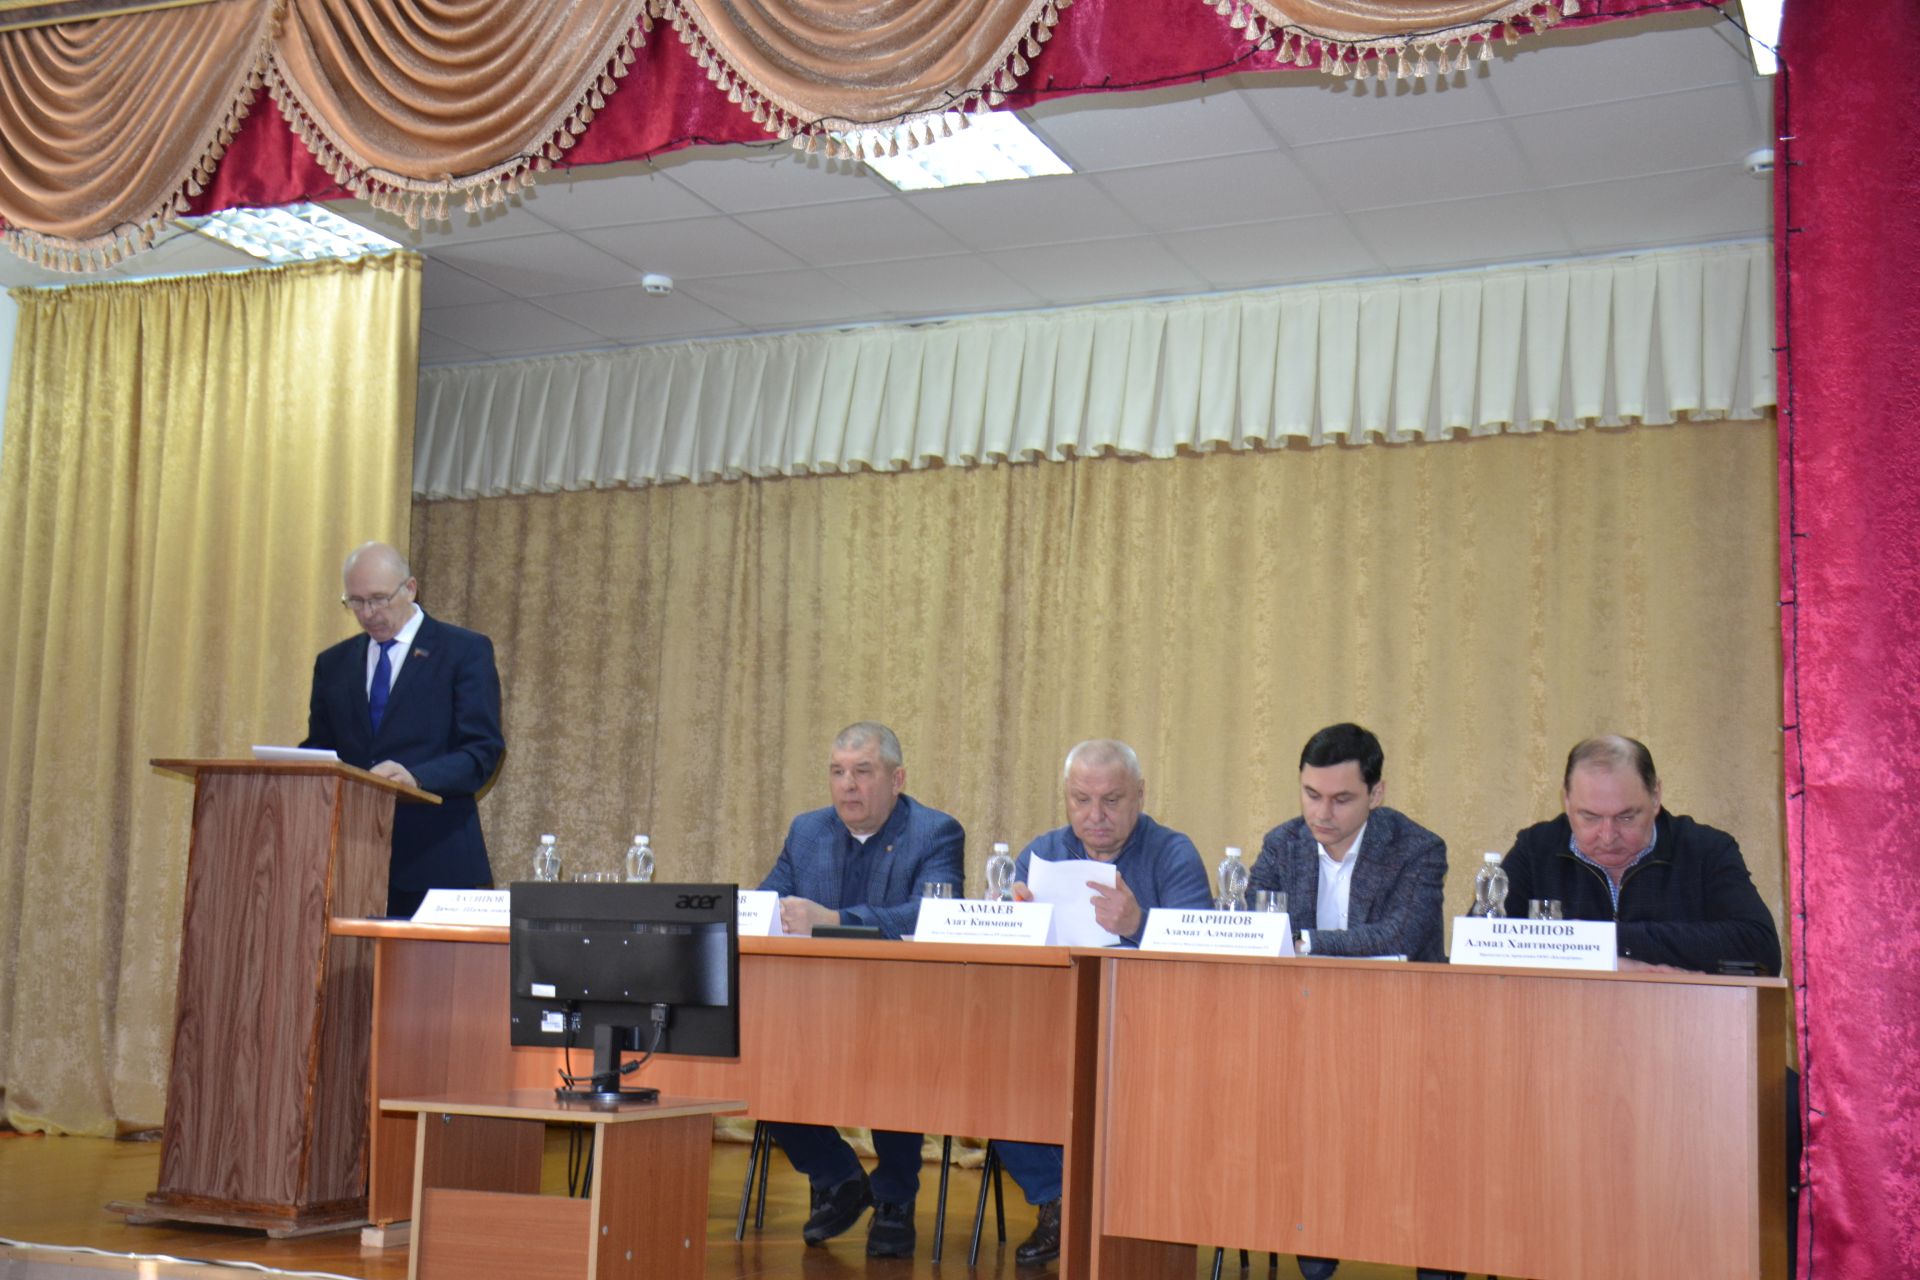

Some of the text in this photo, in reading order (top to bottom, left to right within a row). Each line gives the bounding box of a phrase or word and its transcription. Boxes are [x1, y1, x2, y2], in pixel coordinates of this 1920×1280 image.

[674, 894, 723, 910] acer
[958, 903, 1014, 915] ХАМАЕВ
[1181, 913, 1253, 926] ШАРИПОВ
[1492, 923, 1575, 936] ШАРИПОВ
[1464, 938, 1504, 949] Алмаз
